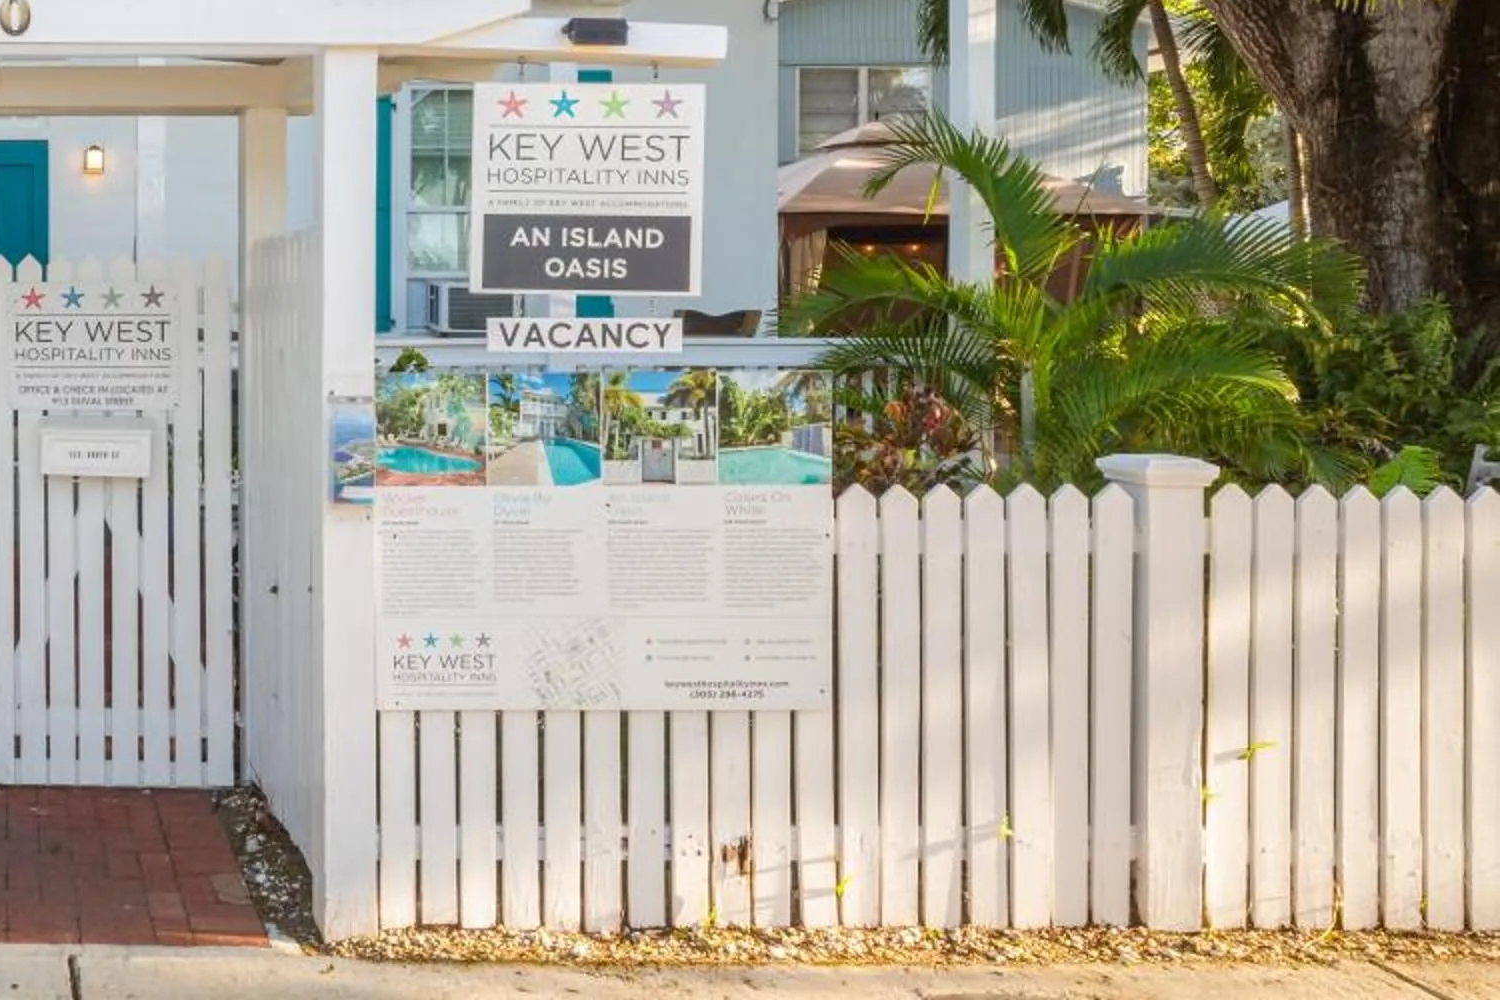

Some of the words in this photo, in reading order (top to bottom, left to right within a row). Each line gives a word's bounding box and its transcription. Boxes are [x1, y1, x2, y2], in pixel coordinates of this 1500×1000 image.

[488, 133, 564, 161] KEY
[579, 134, 690, 163] WEST
[487, 167, 629, 185] HOSPITALITY
[636, 169, 689, 187] INNS
[510, 227, 550, 247] AN
[561, 228, 664, 249] ISLAND
[545, 257, 628, 279] OASIS
[15, 321, 73, 342] KEY
[85, 321, 171, 342] WEST
[500, 322, 671, 348] VACANCY
[14, 347, 124, 361] HOSPITALITY
[132, 348, 171, 361] INNS
[18, 385, 49, 394] OFFICE
[63, 385, 94, 394] CHECK
[98, 385, 108, 394] IN
[111, 385, 154, 394] LOCATED
[393, 655, 431, 669] KEY
[439, 655, 496, 669] WEST
